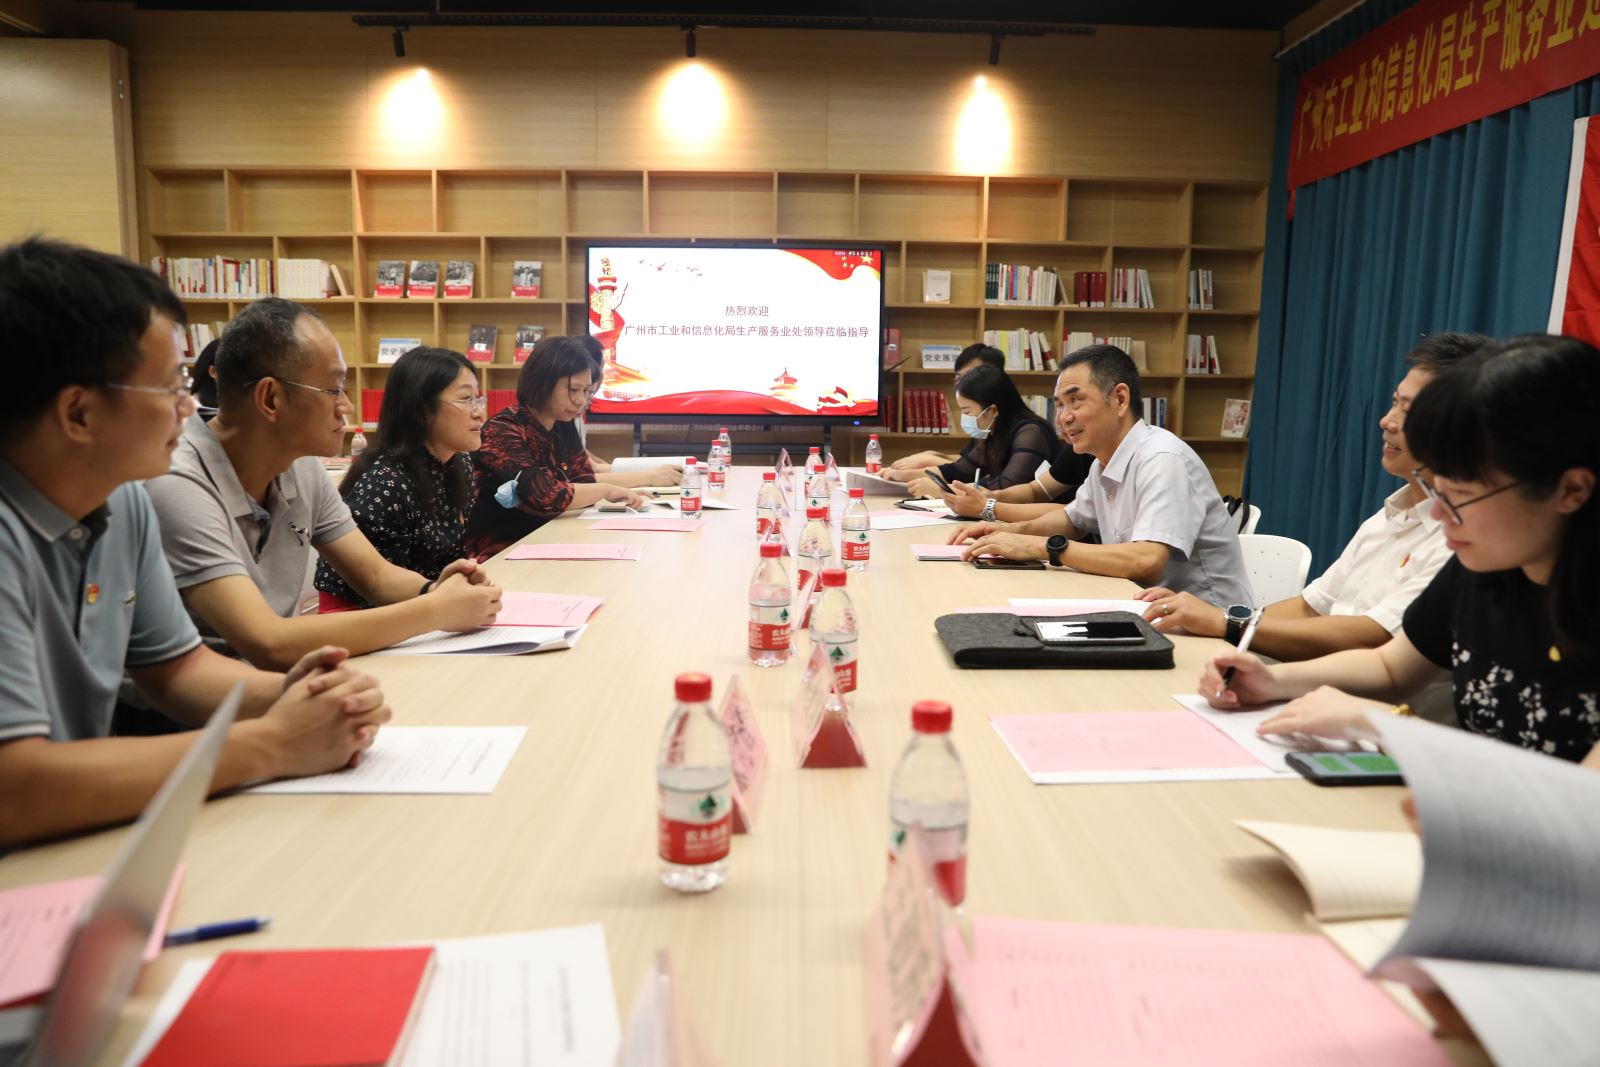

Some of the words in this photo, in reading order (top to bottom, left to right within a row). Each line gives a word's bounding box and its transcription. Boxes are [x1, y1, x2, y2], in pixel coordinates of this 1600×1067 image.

[725, 305, 769, 317] 热烈欢迎
[624, 325, 870, 338] 广州市工业和信息化局生产服务业处领导莅临指导
